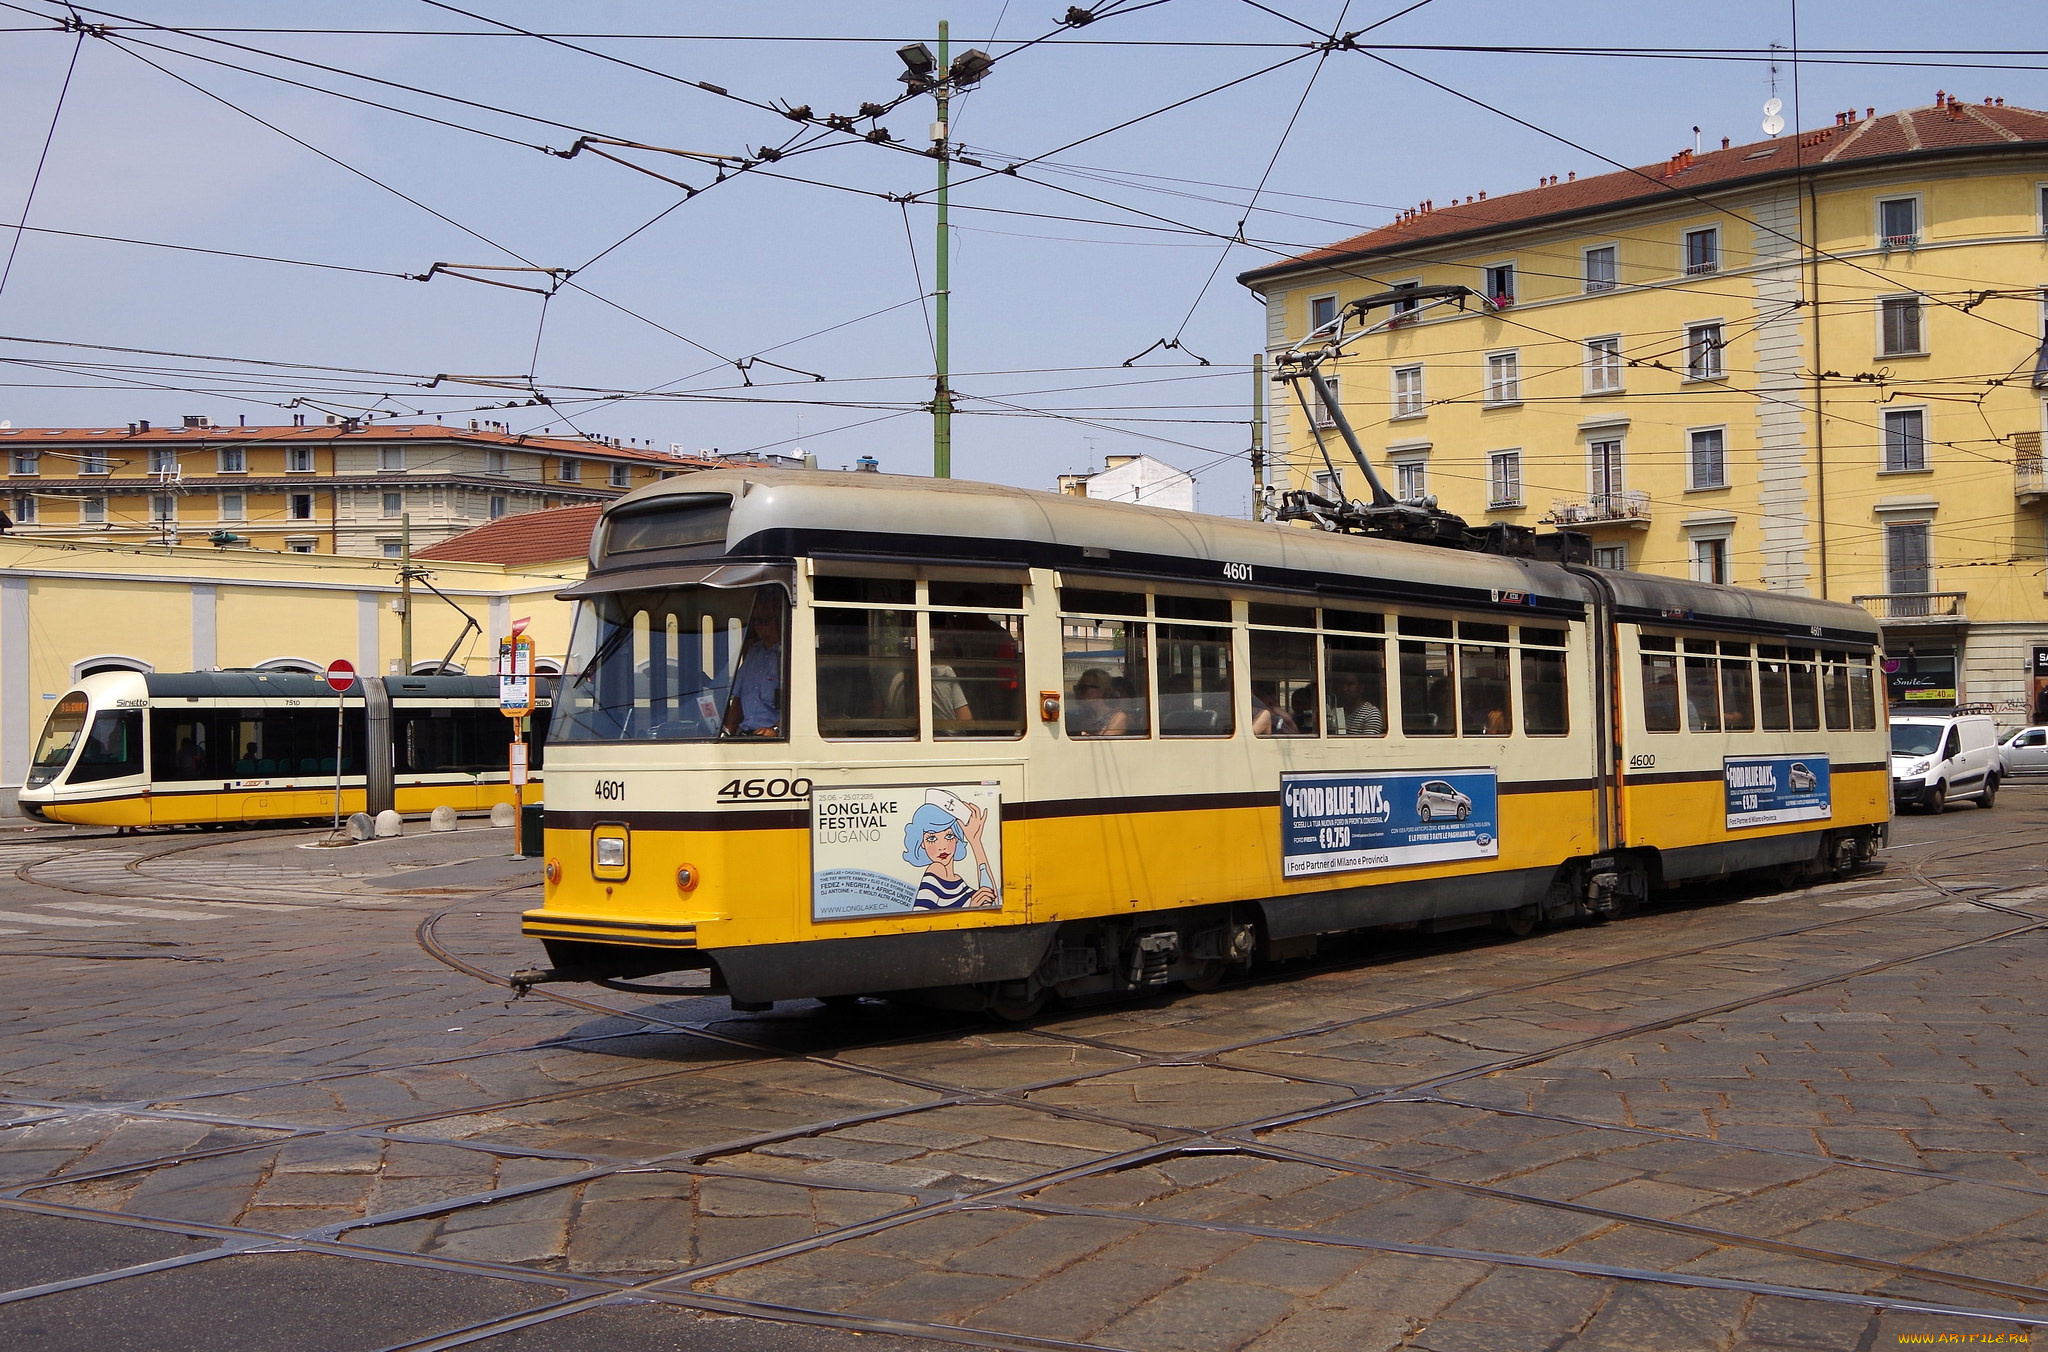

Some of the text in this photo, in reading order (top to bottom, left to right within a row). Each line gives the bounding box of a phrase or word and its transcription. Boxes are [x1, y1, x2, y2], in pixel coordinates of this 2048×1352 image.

[1223, 562, 1253, 581] 4601
[1629, 754, 1656, 766] 4600
[594, 779, 626, 801] 4601
[717, 777, 813, 799] 4600
[819, 802, 898, 816] LONGLAKE
[1326, 786, 1354, 816] BLUE
[819, 816, 887, 830] FESTIVAL
[819, 829, 880, 844] LUGANO
[1291, 861, 1305, 872] Ford
[1306, 859, 1330, 870] Partner
[1330, 858, 1336, 868] di
[1337, 856, 1356, 868] Milano
[1362, 854, 1389, 865] Provincia
[820, 881, 913, 904] FEDEZ NEGRITA AFRICA UNITE
[877, 893, 890, 901] ALTRI
[820, 904, 888, 914] WWW.LONGLAKE.CH
